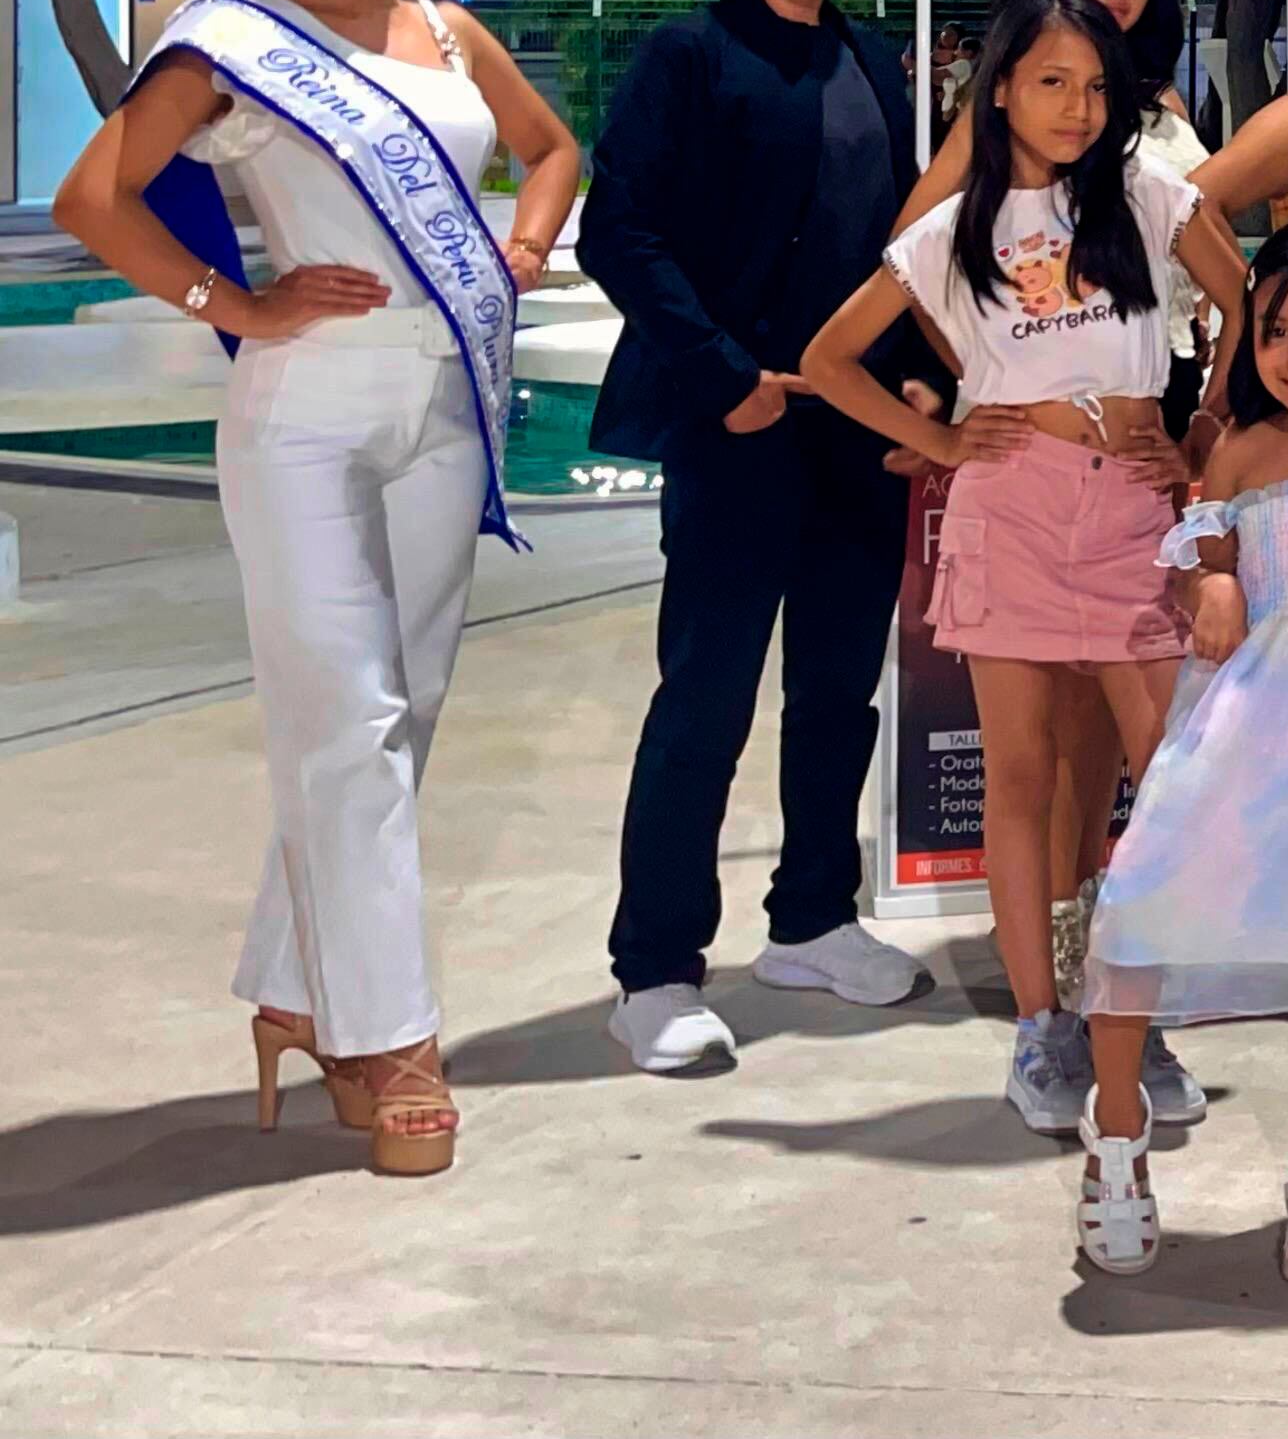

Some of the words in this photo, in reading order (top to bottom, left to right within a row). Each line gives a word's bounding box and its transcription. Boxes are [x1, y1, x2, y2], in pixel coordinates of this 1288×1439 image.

[258, 48, 366, 124] Reina
[373, 133, 438, 198] Del
[948, 734, 983, 747] TALL
[916, 858, 971, 876] INFORMES
